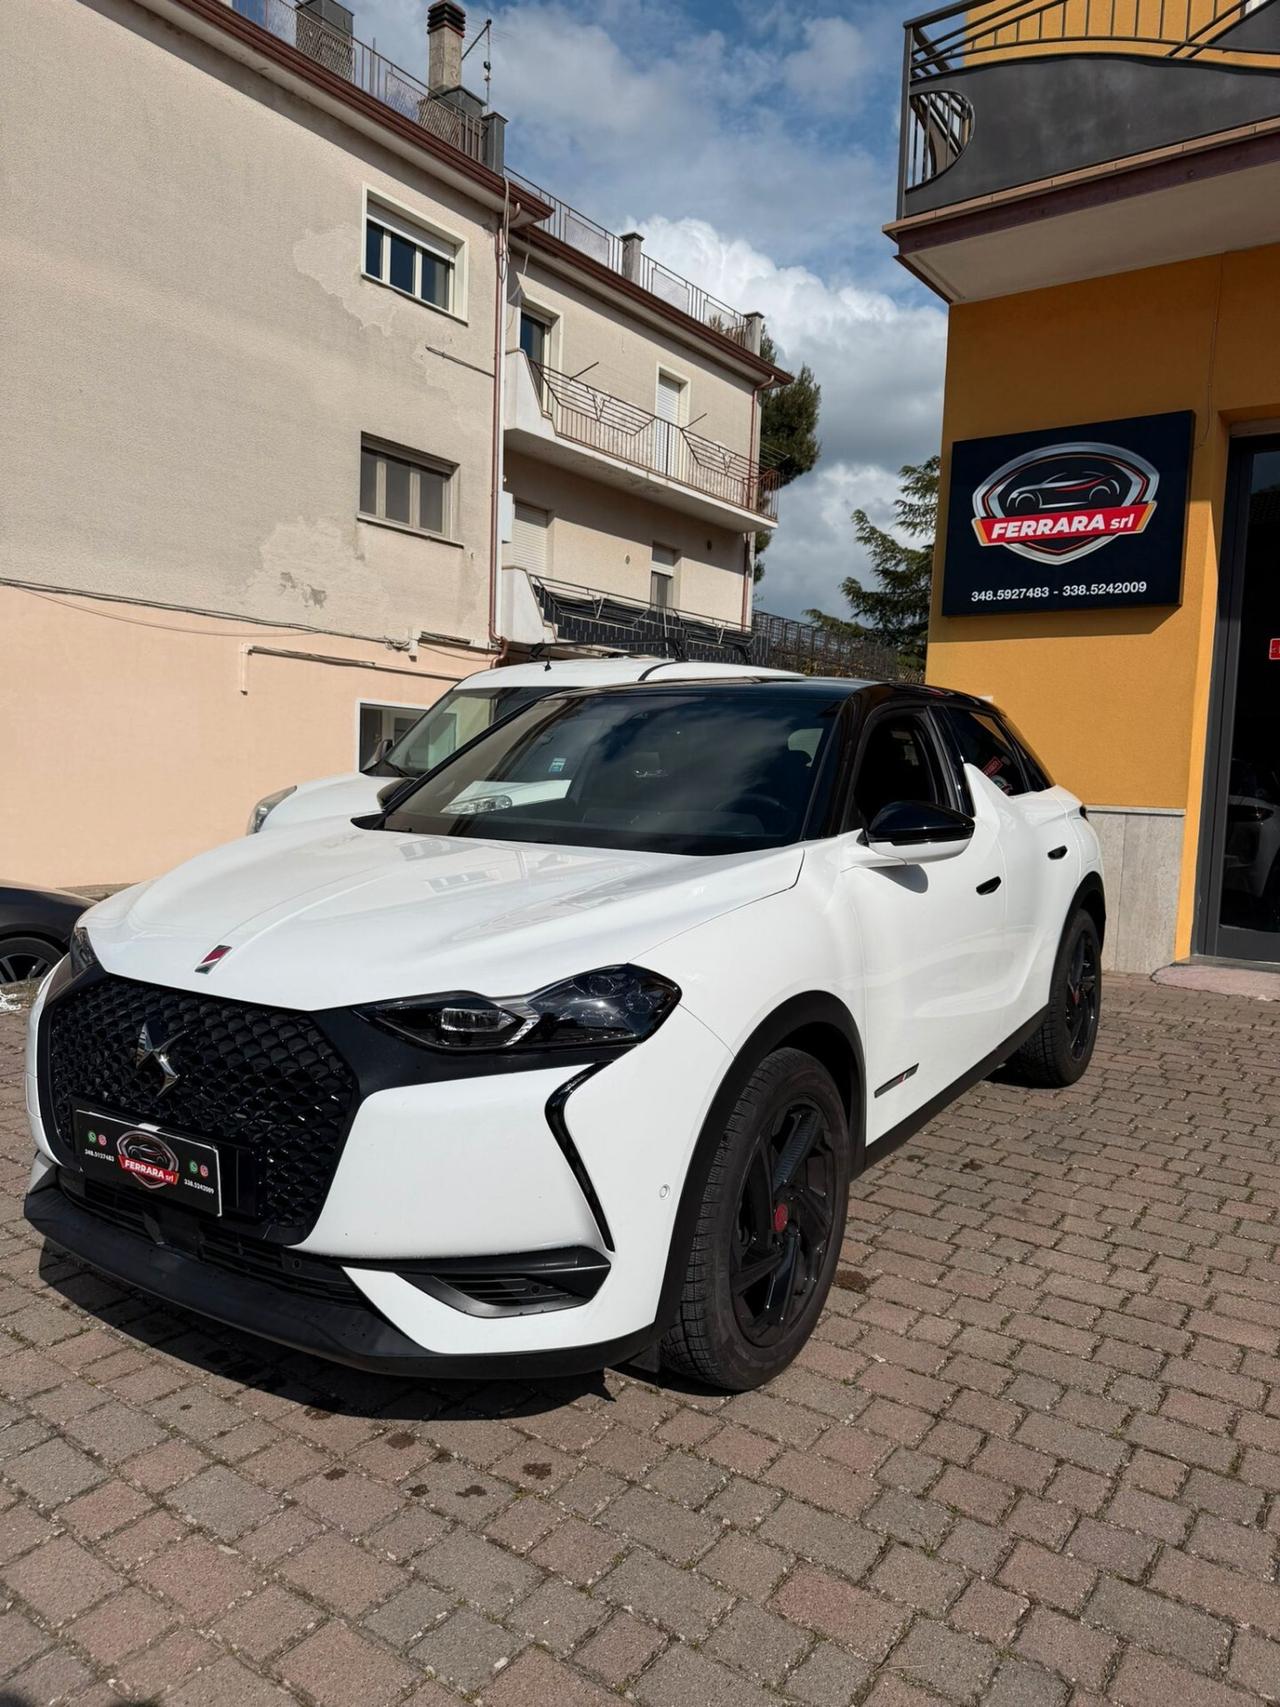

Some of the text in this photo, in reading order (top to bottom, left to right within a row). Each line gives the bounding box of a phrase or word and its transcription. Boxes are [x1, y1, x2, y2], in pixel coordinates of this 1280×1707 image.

[991, 513, 1134, 539] FERRARA srl
[971, 586, 1049, 602] 348.5927483
[1062, 581, 1147, 597] 338.5242009
[124, 1160, 174, 1182] FERRARA srl
